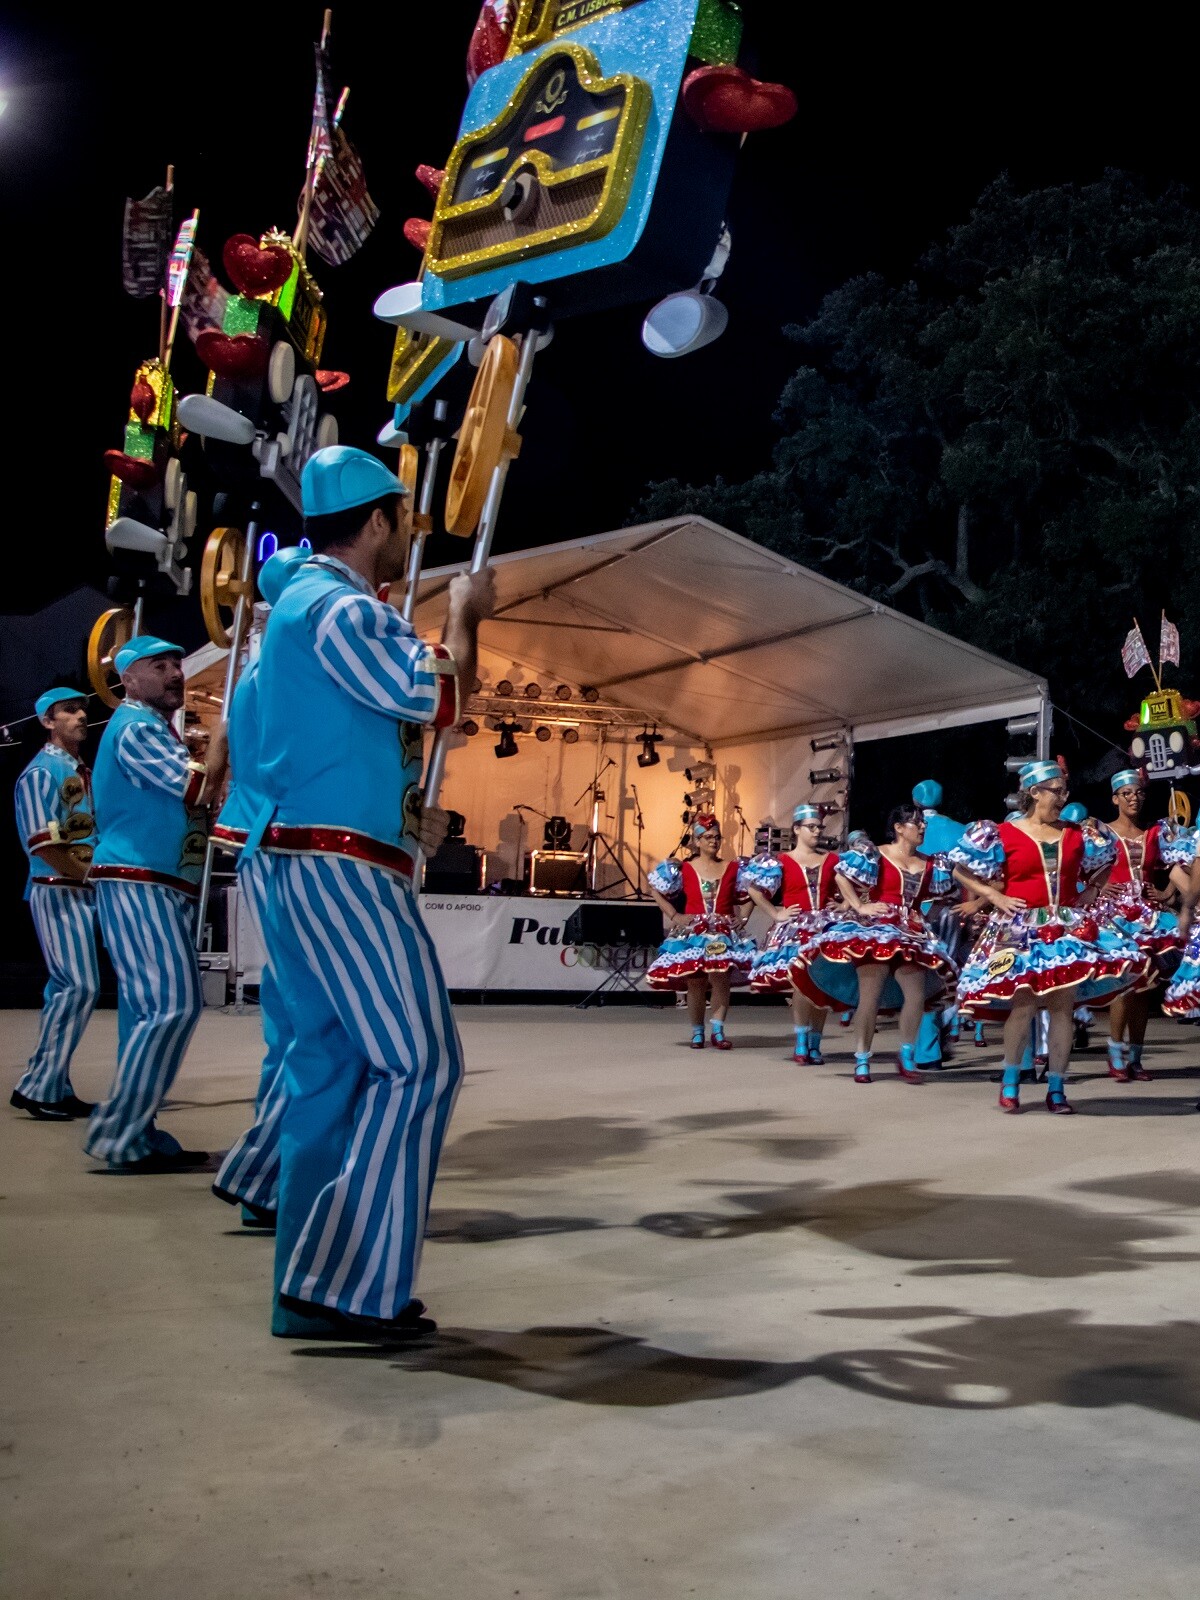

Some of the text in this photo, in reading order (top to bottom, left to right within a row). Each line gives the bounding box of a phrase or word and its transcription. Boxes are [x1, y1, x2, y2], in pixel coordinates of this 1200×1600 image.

[578, 0, 616, 17] LISBO
[1151, 703, 1166, 714] TAXI
[425, 902, 444, 910] COM
